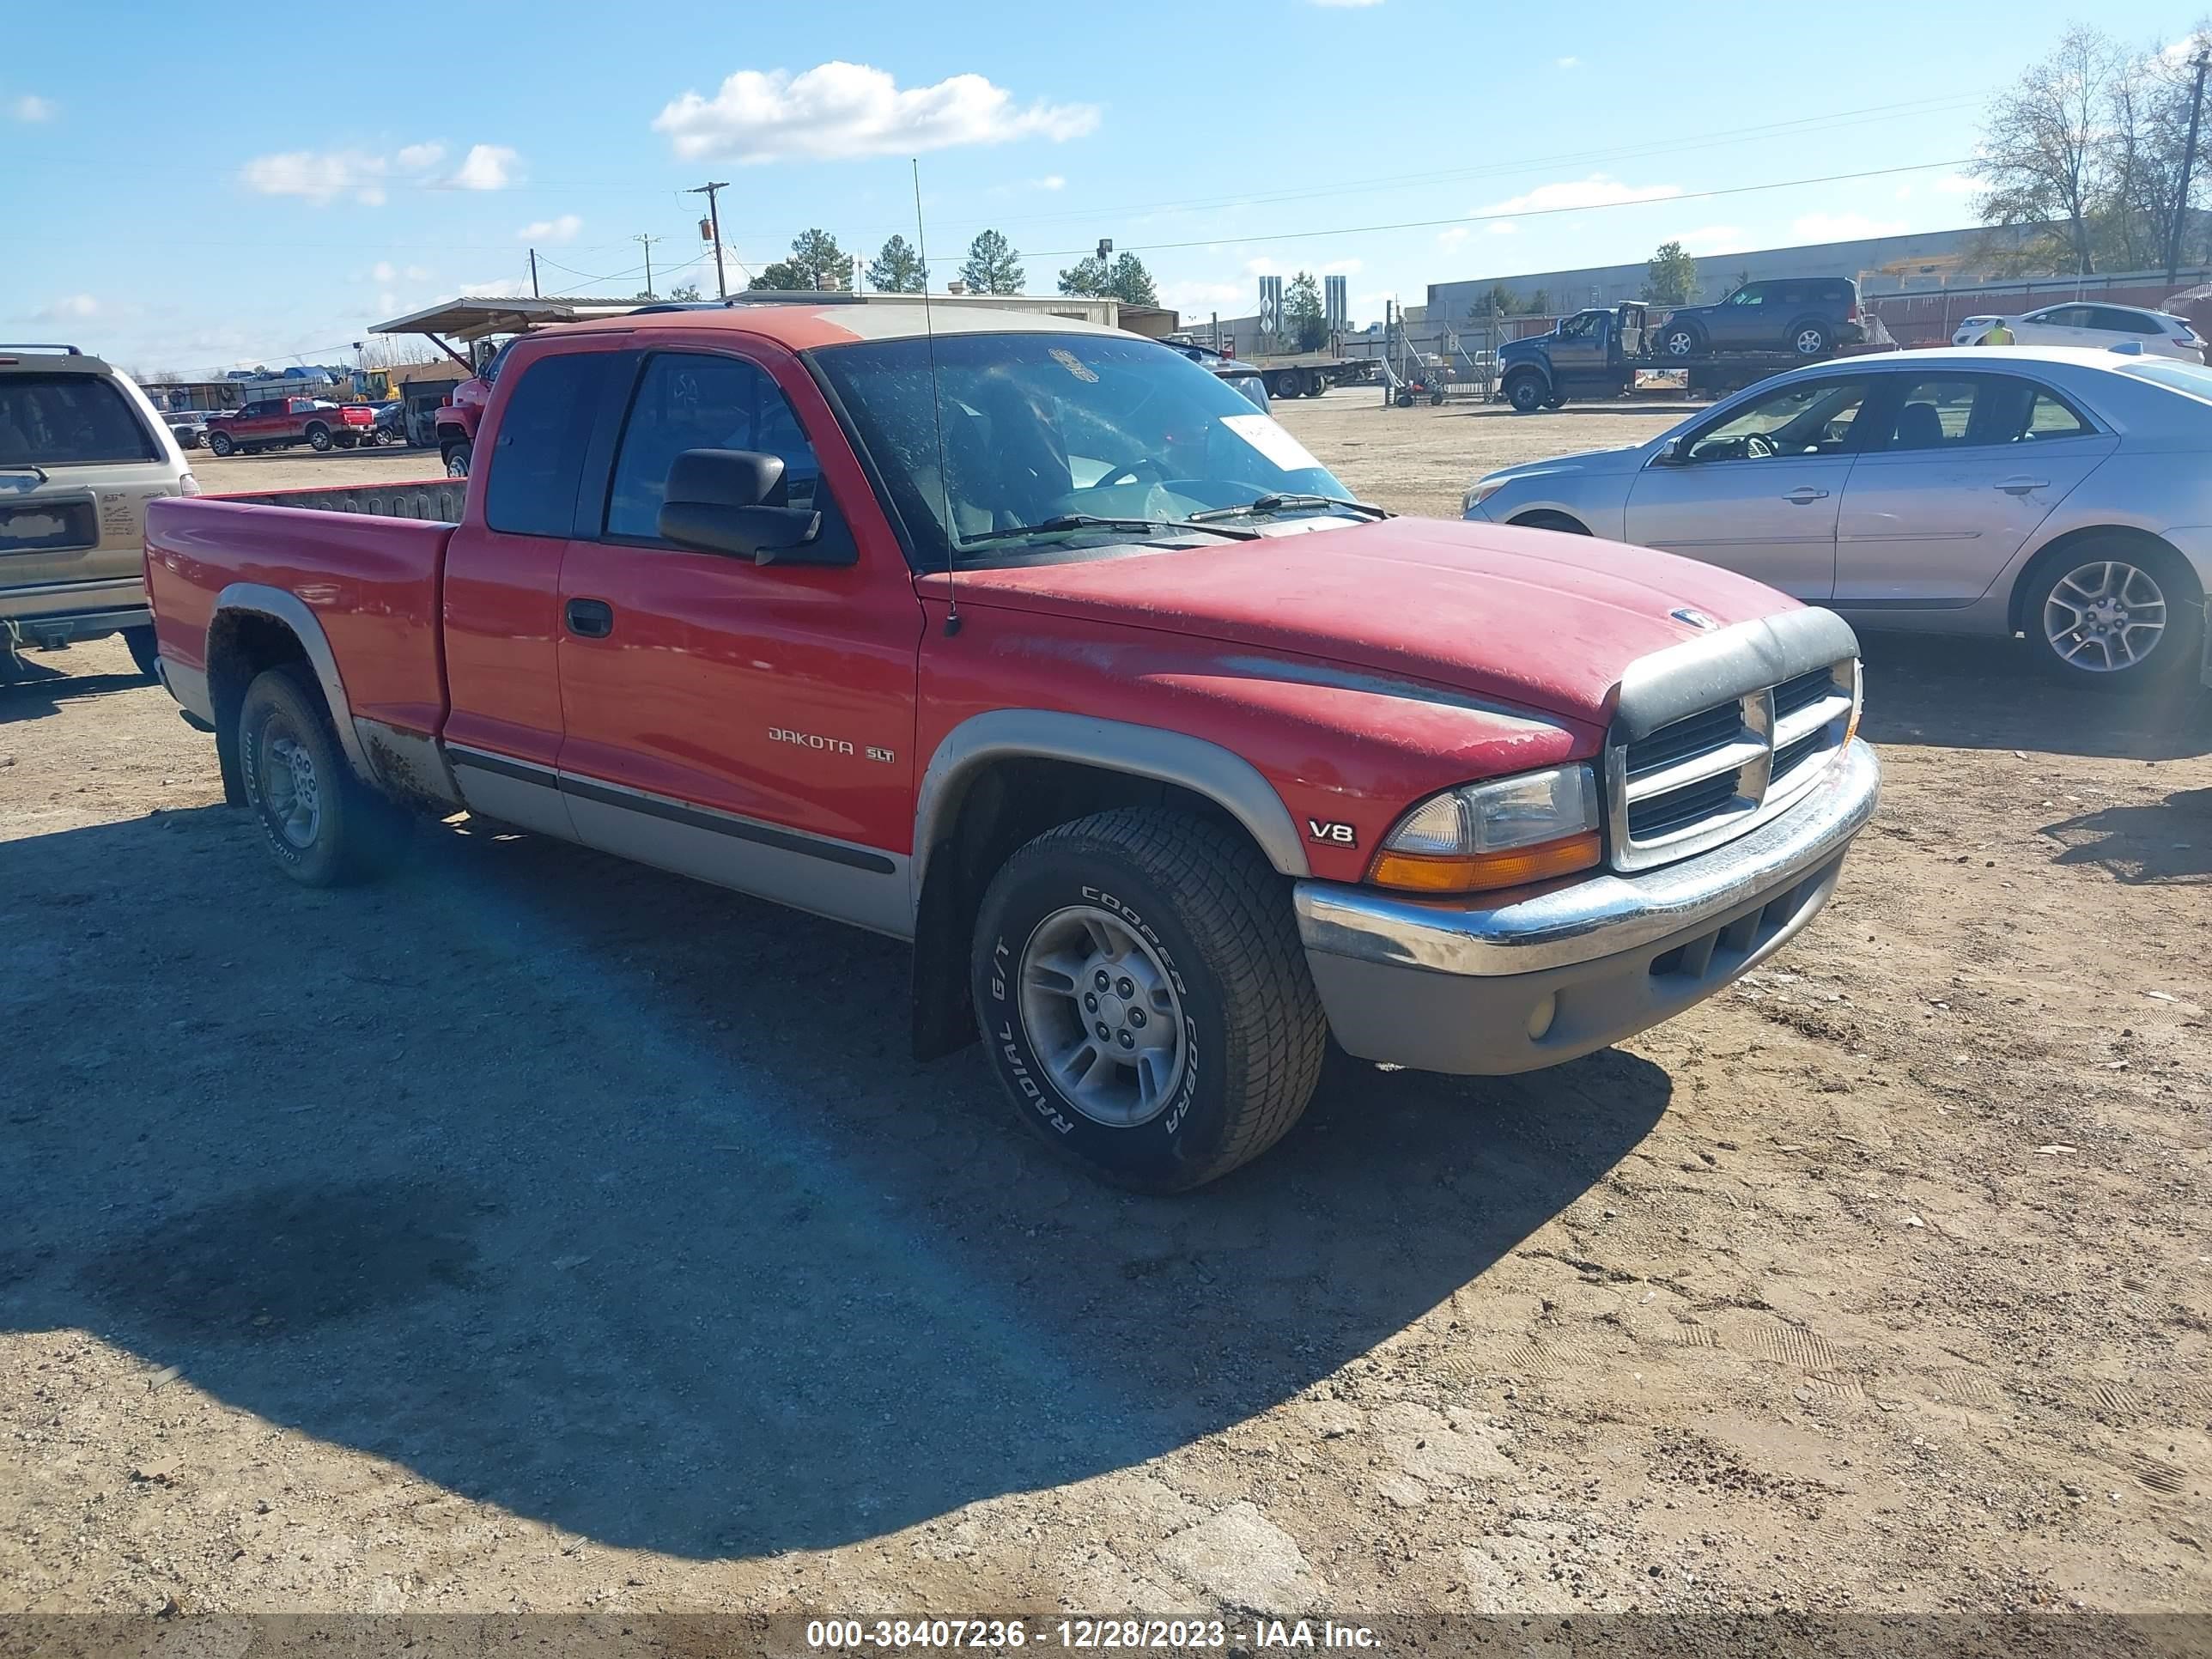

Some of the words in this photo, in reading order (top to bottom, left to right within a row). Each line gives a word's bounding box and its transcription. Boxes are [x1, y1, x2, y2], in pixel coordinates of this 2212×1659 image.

[769, 726, 854, 756] DAKOTA
[866, 748, 894, 763] SLT
[1308, 820, 1354, 842] V8
[992, 936, 1010, 1001] G/T
[1082, 885, 1188, 996] COOPER
[999, 1021, 1076, 1135] RADIAL
[1165, 1014, 1203, 1135] COBRA
